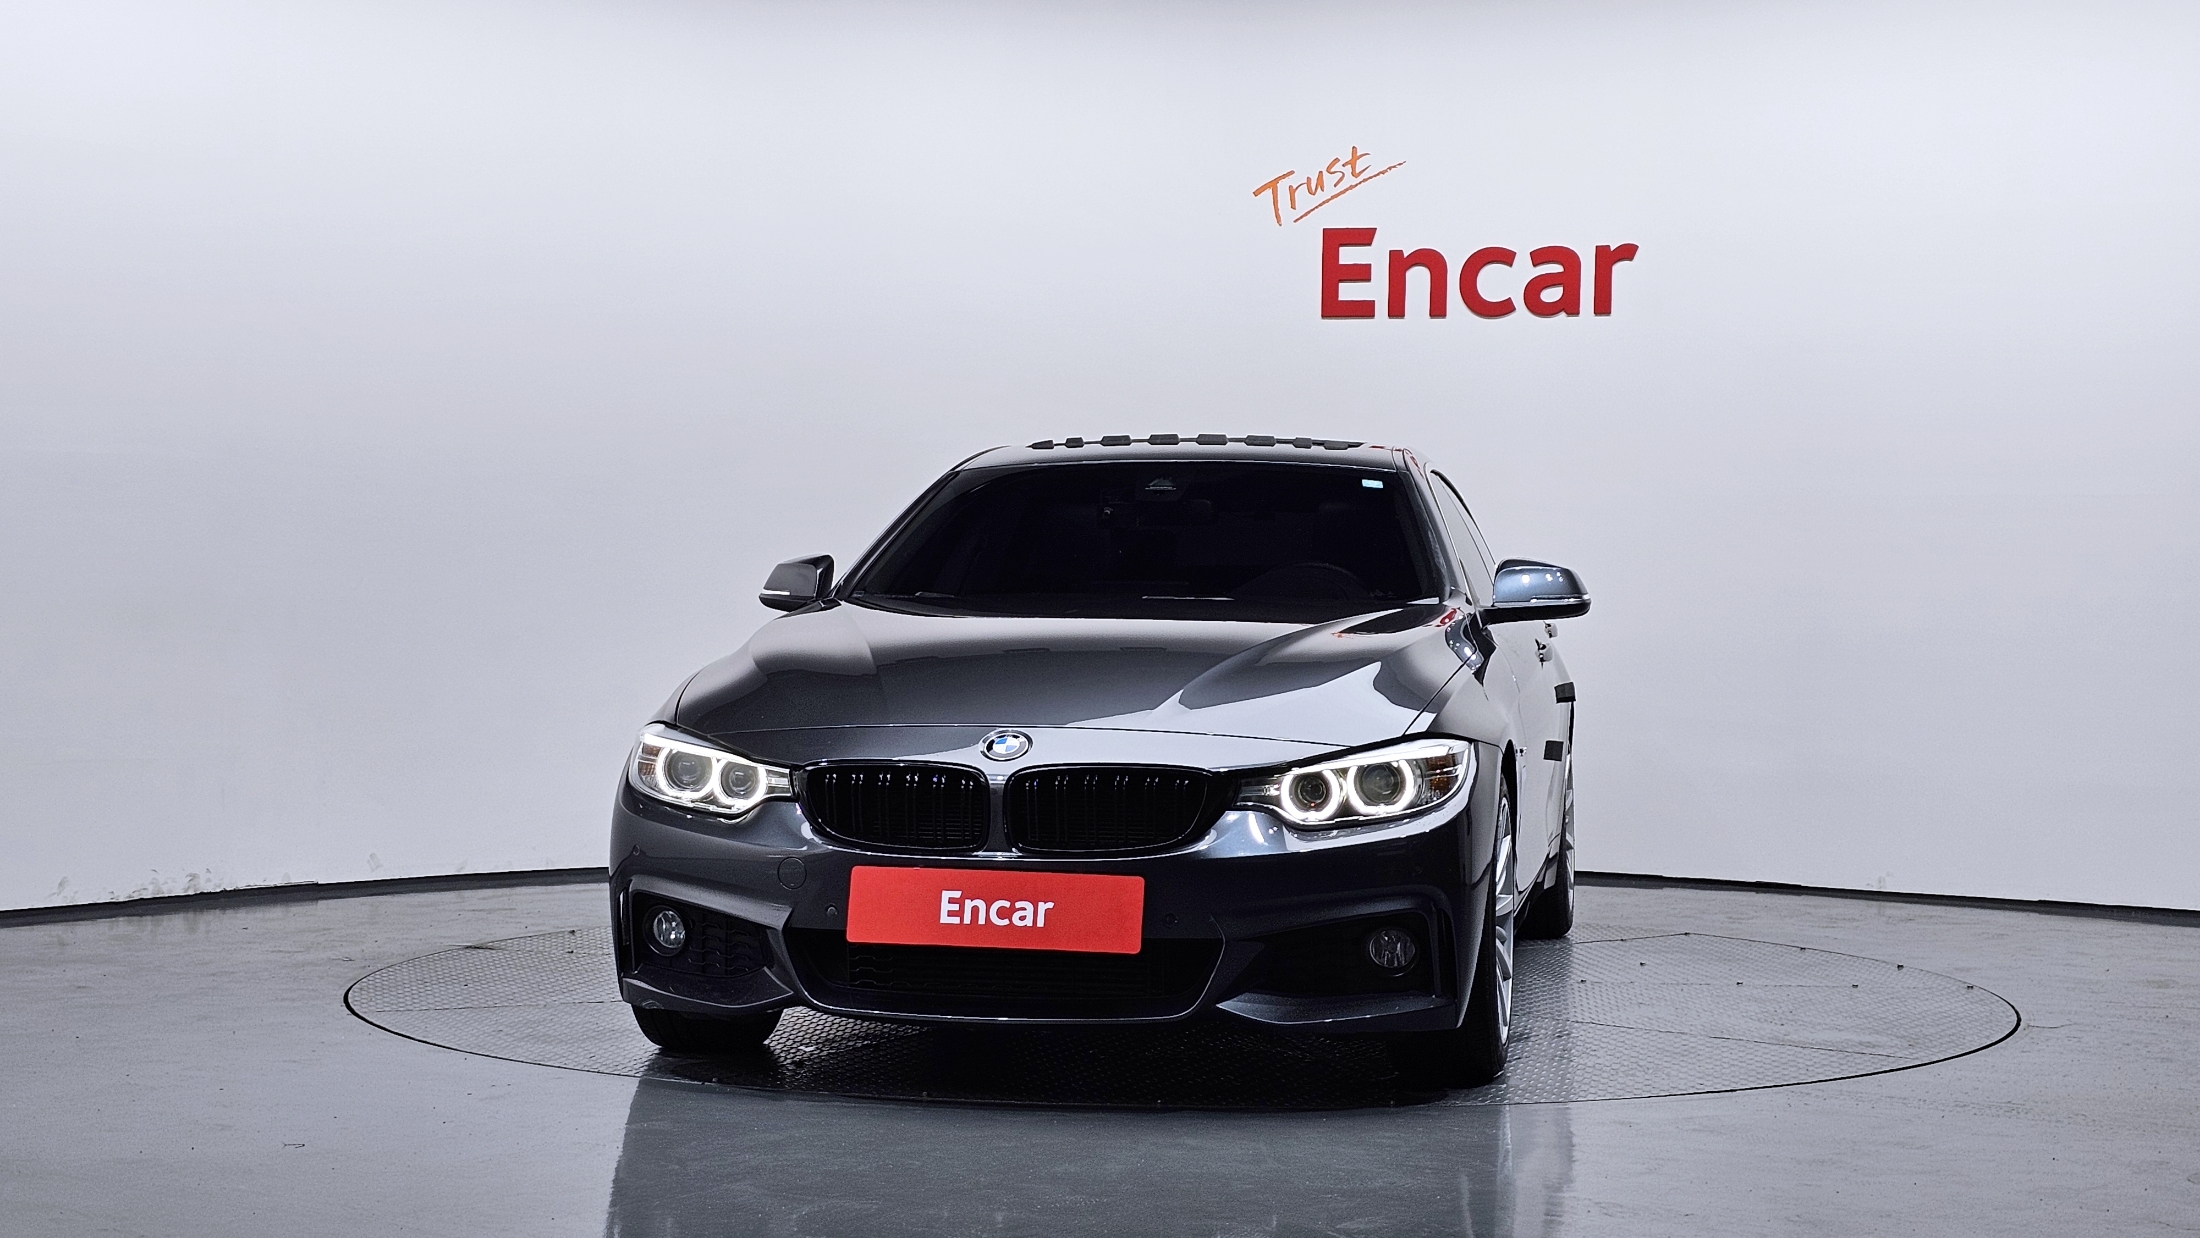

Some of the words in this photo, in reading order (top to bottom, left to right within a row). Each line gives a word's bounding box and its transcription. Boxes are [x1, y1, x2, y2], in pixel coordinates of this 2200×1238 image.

[1253, 146, 1372, 226] Trust
[1321, 228, 1639, 318] Encar
[939, 890, 1055, 928] Encar
